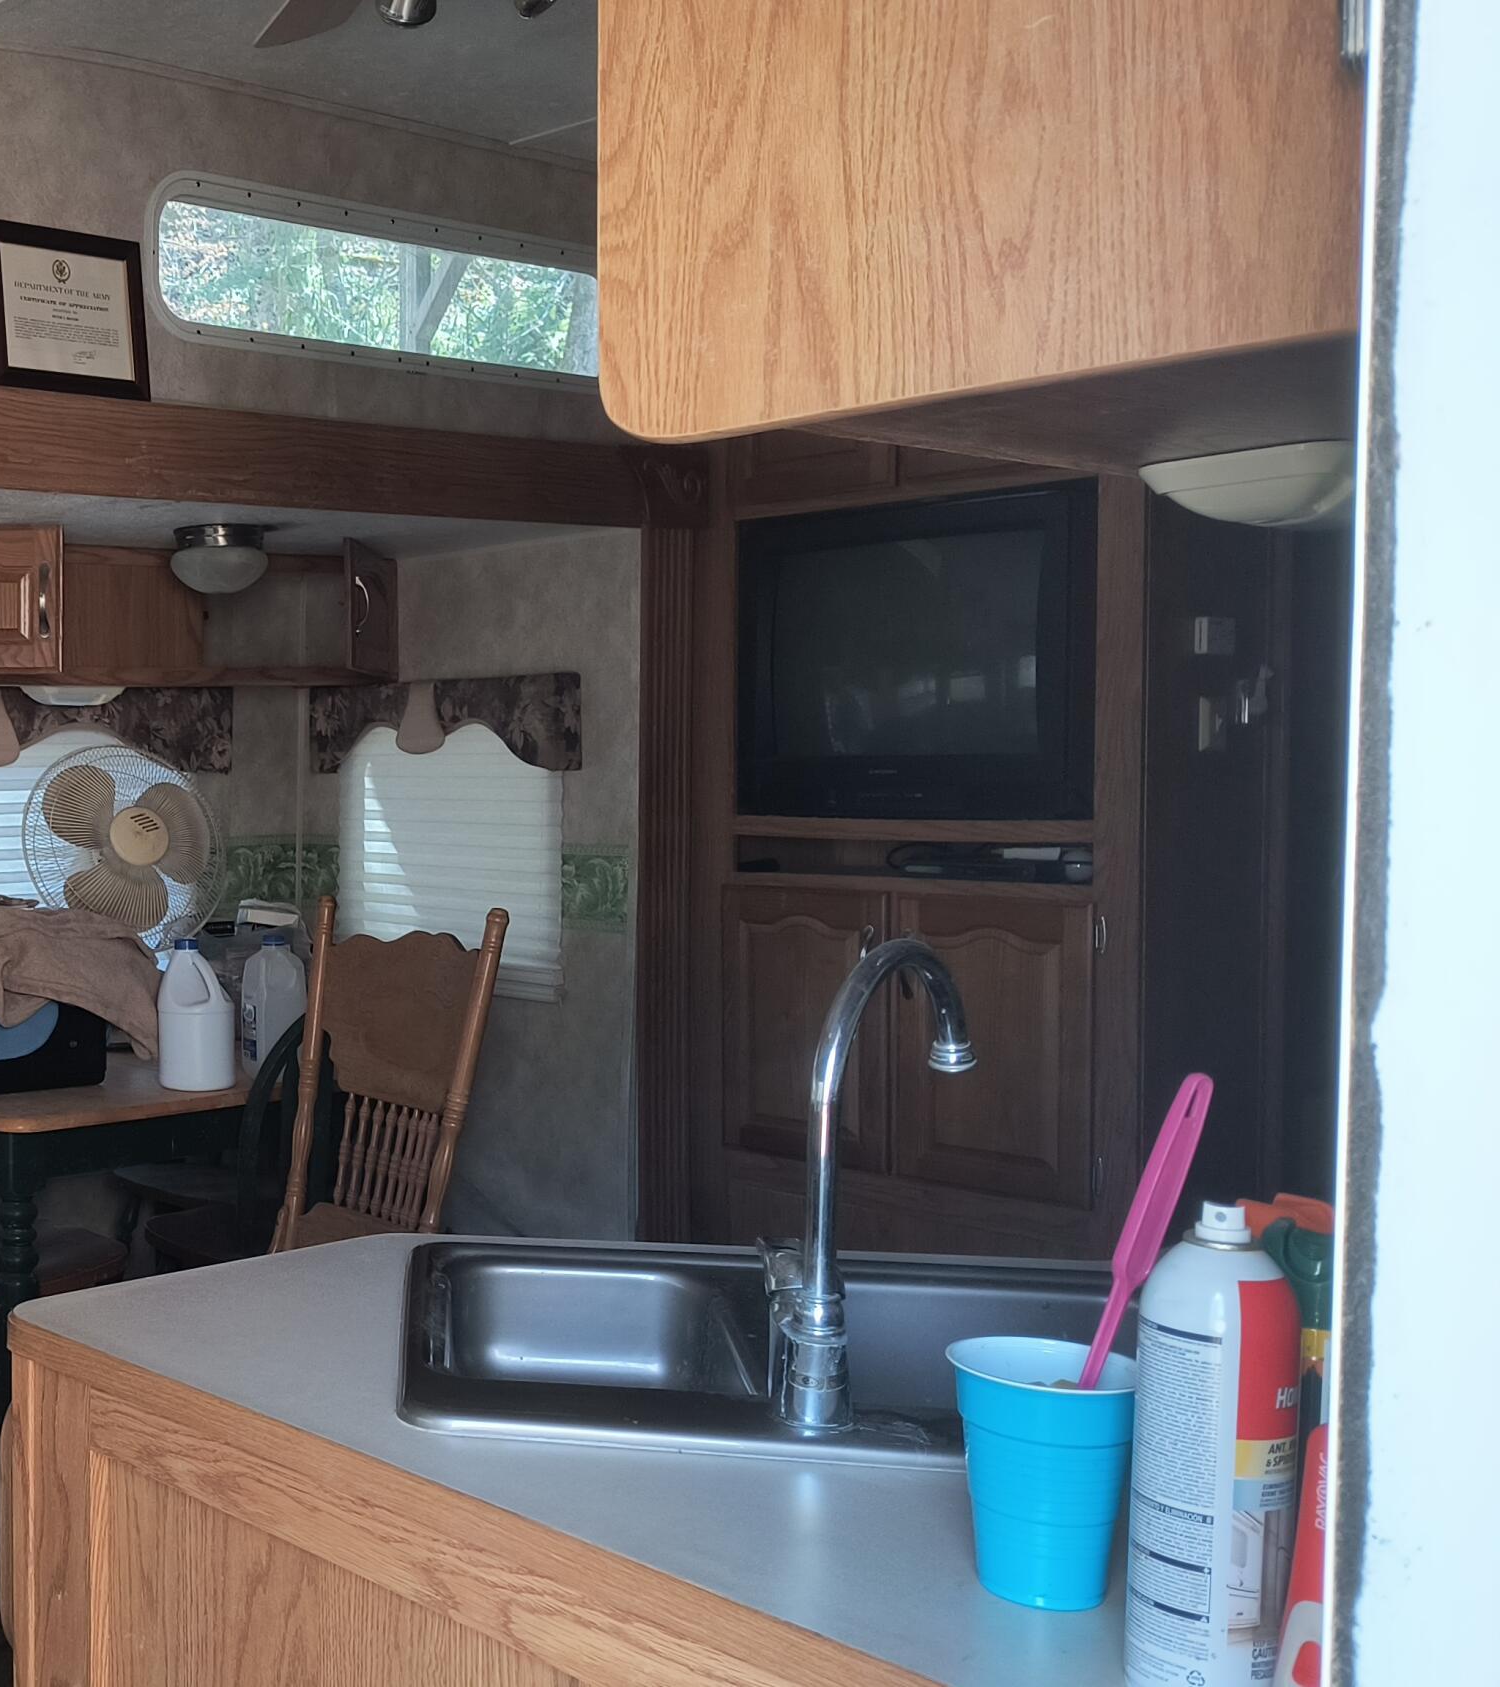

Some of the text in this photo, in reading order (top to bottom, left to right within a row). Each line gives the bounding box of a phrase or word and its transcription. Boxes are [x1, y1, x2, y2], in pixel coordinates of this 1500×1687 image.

[14, 281, 63, 295] DEPARTMENT
[76, 290, 89, 298] THE
[92, 292, 111, 301] ARMY
[20, 295, 57, 306] CERTIFICATE
